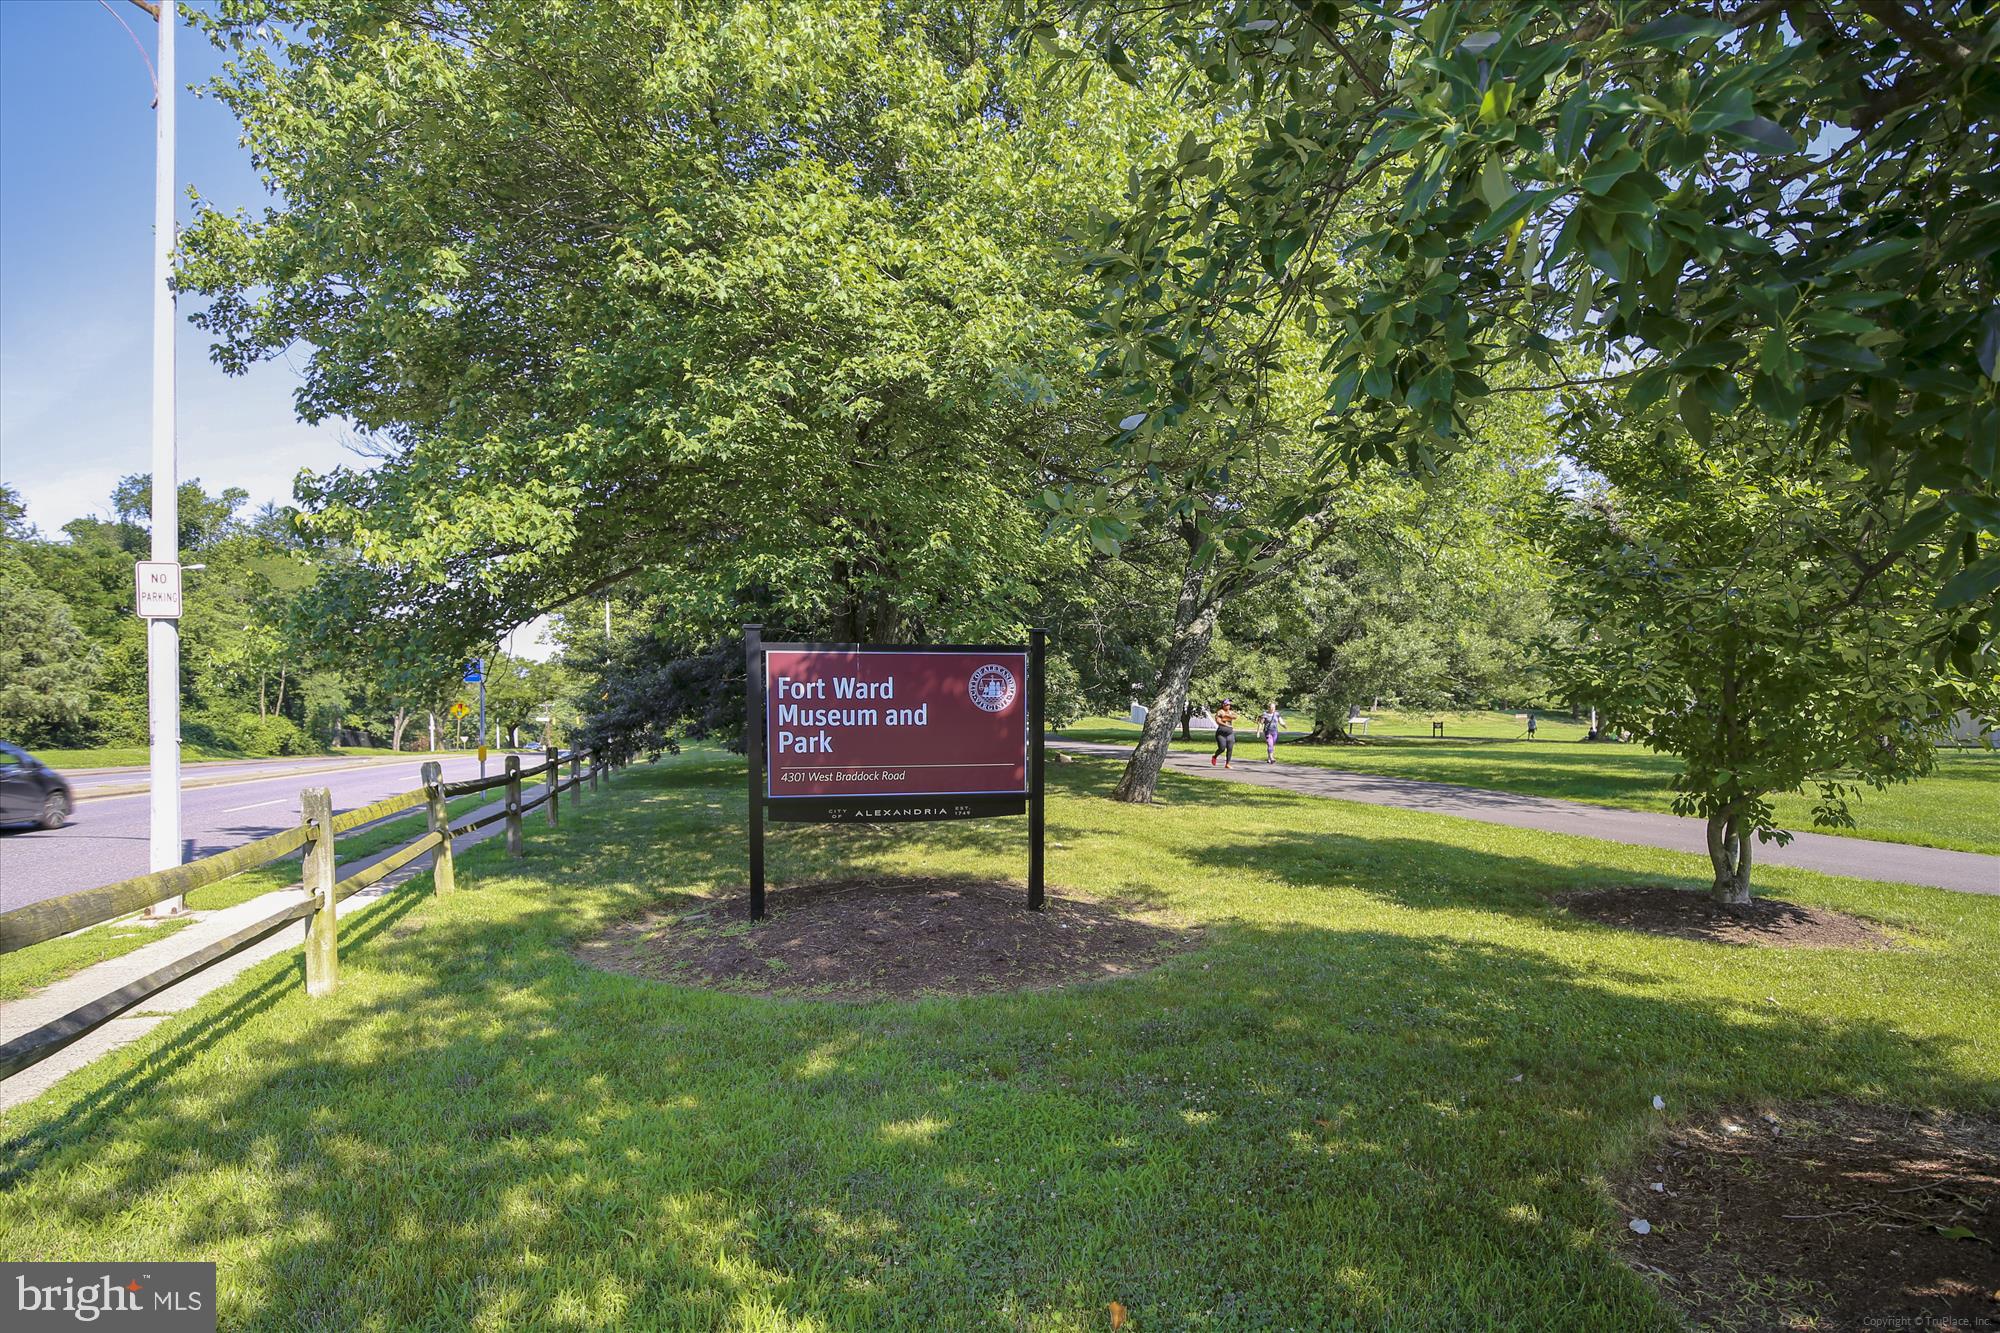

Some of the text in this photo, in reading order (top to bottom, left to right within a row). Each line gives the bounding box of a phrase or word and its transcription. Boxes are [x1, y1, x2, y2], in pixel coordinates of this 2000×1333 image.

[151, 574, 167, 584] NO
[141, 592, 177, 603] PARKING
[778, 677, 894, 699] Fort Ward
[778, 703, 928, 726] Museum and
[778, 731, 833, 753] Park
[781, 770, 905, 782] 4301 West Braddock Road
[855, 808, 948, 817] ALEXANDRIA
